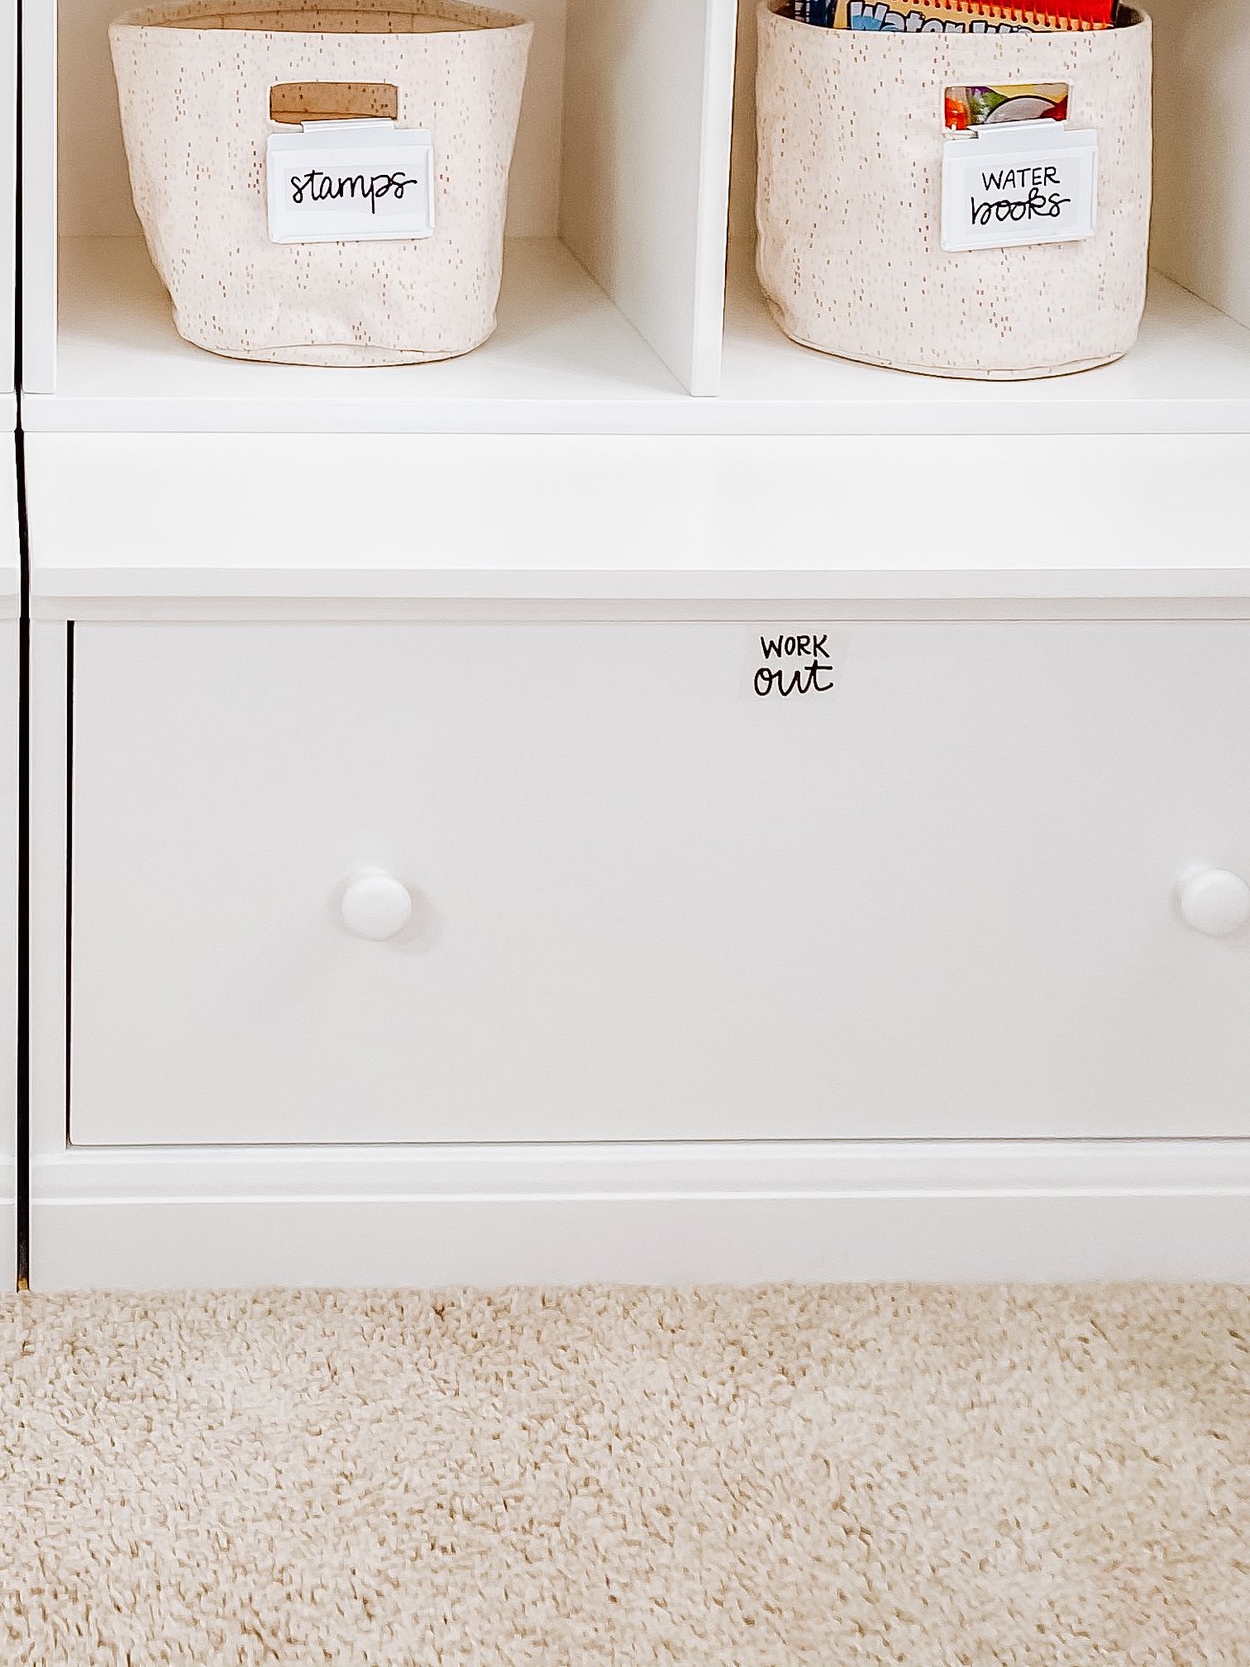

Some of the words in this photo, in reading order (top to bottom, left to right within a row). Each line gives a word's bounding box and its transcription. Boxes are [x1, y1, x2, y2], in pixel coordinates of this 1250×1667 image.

[291, 170, 418, 214] stamps
[982, 166, 1060, 191] WATER
[970, 189, 1070, 225] books
[760, 634, 830, 659] WORK
[754, 659, 833, 696] out
